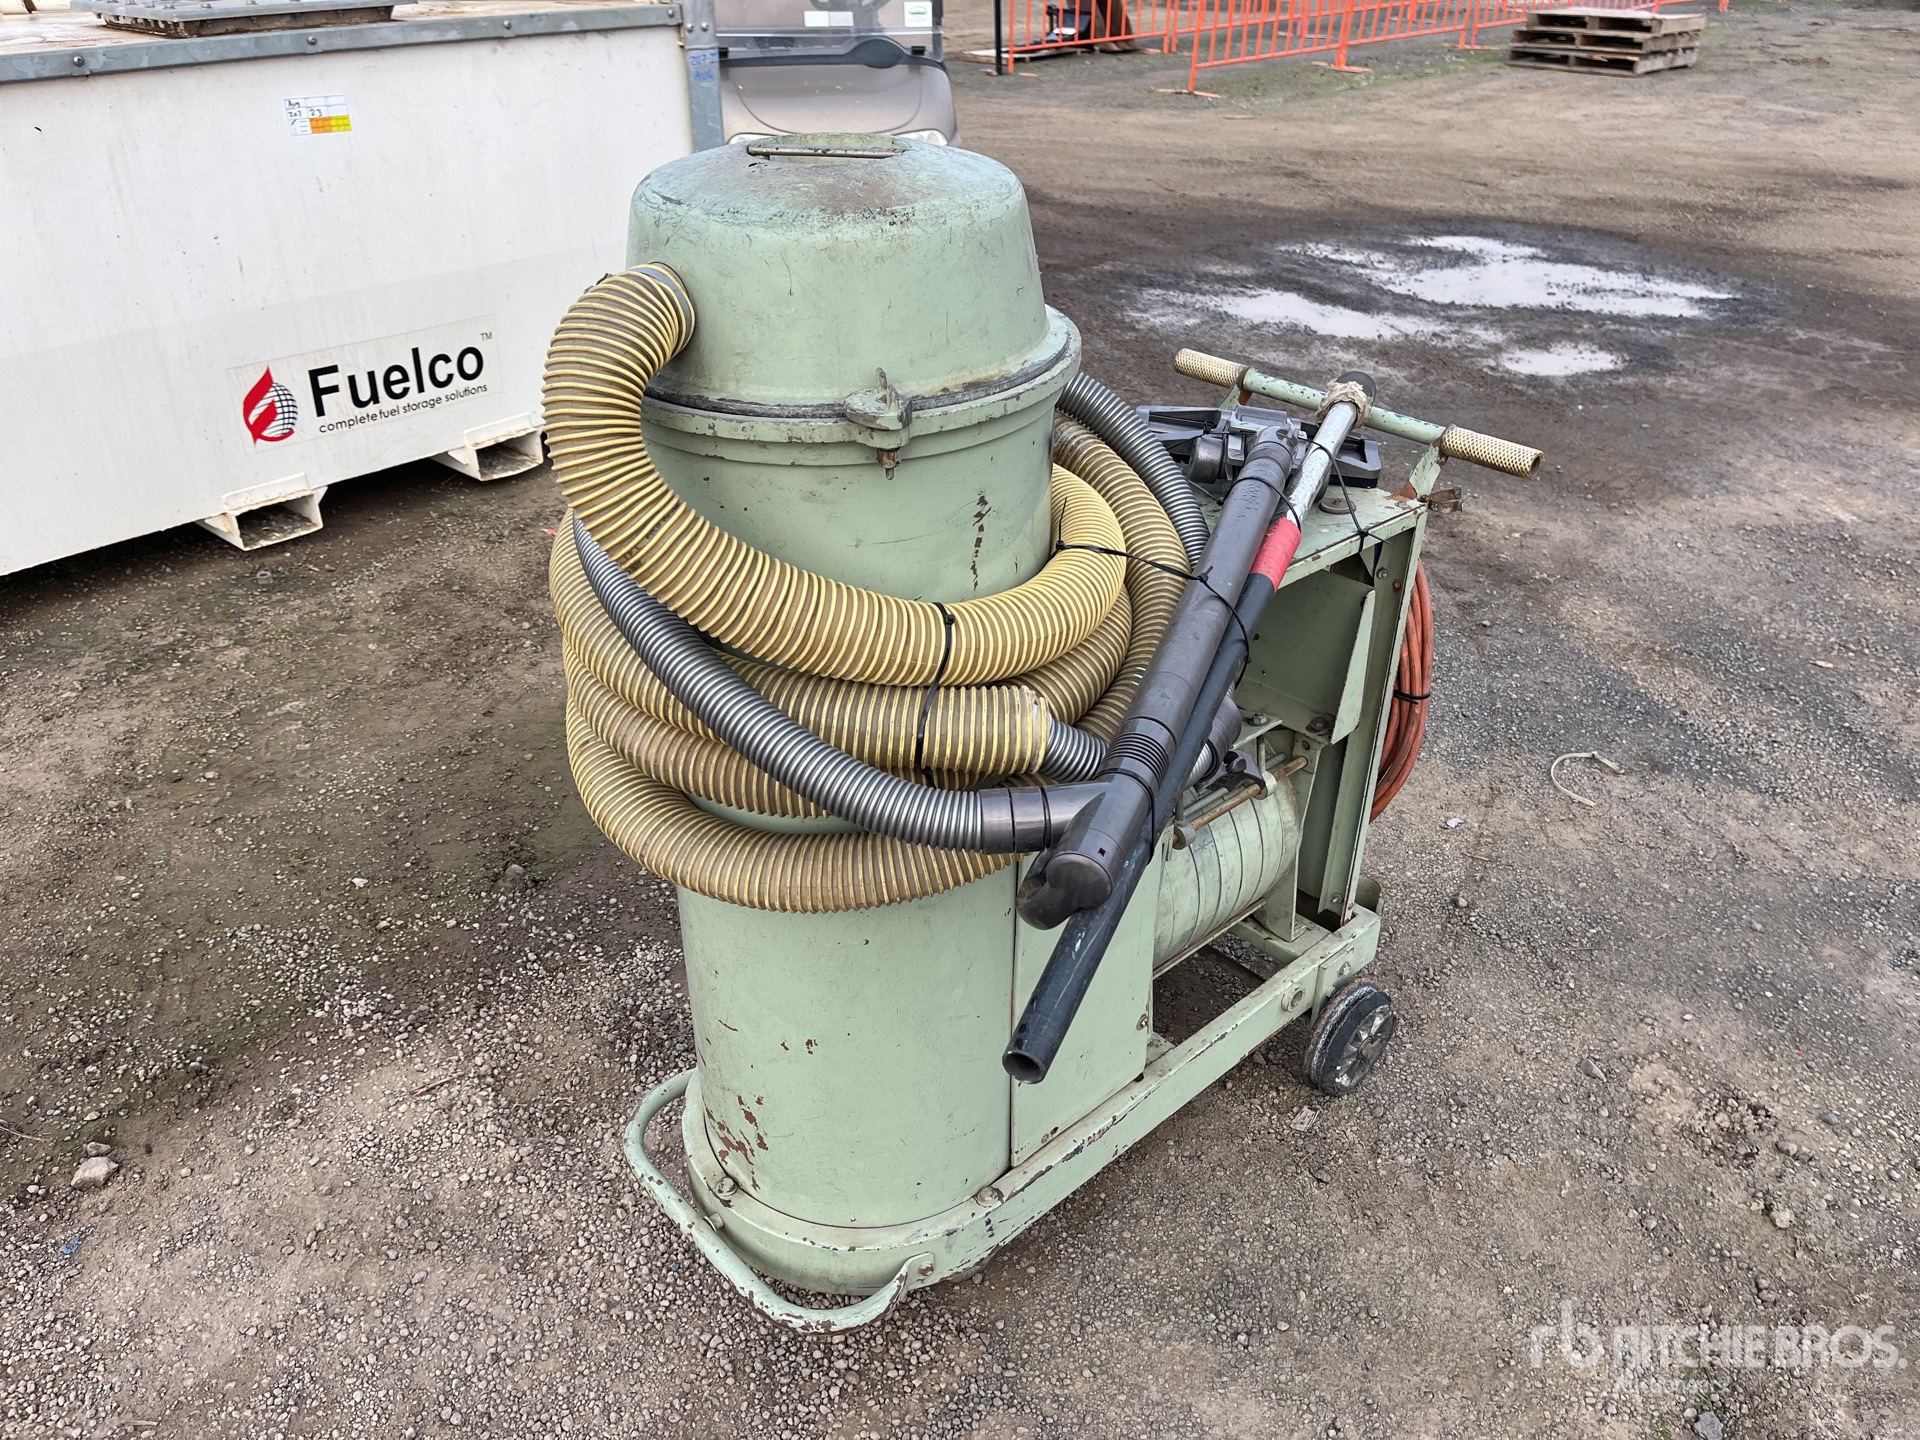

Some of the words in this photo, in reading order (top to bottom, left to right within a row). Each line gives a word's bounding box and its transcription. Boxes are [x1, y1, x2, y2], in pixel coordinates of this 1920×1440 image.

[309, 108, 323, 117] 23
[308, 346, 484, 418] Fuelco
[319, 411, 378, 434] complete
[379, 405, 400, 421] fuel
[402, 395, 442, 415] storage
[445, 383, 488, 403] solutions
